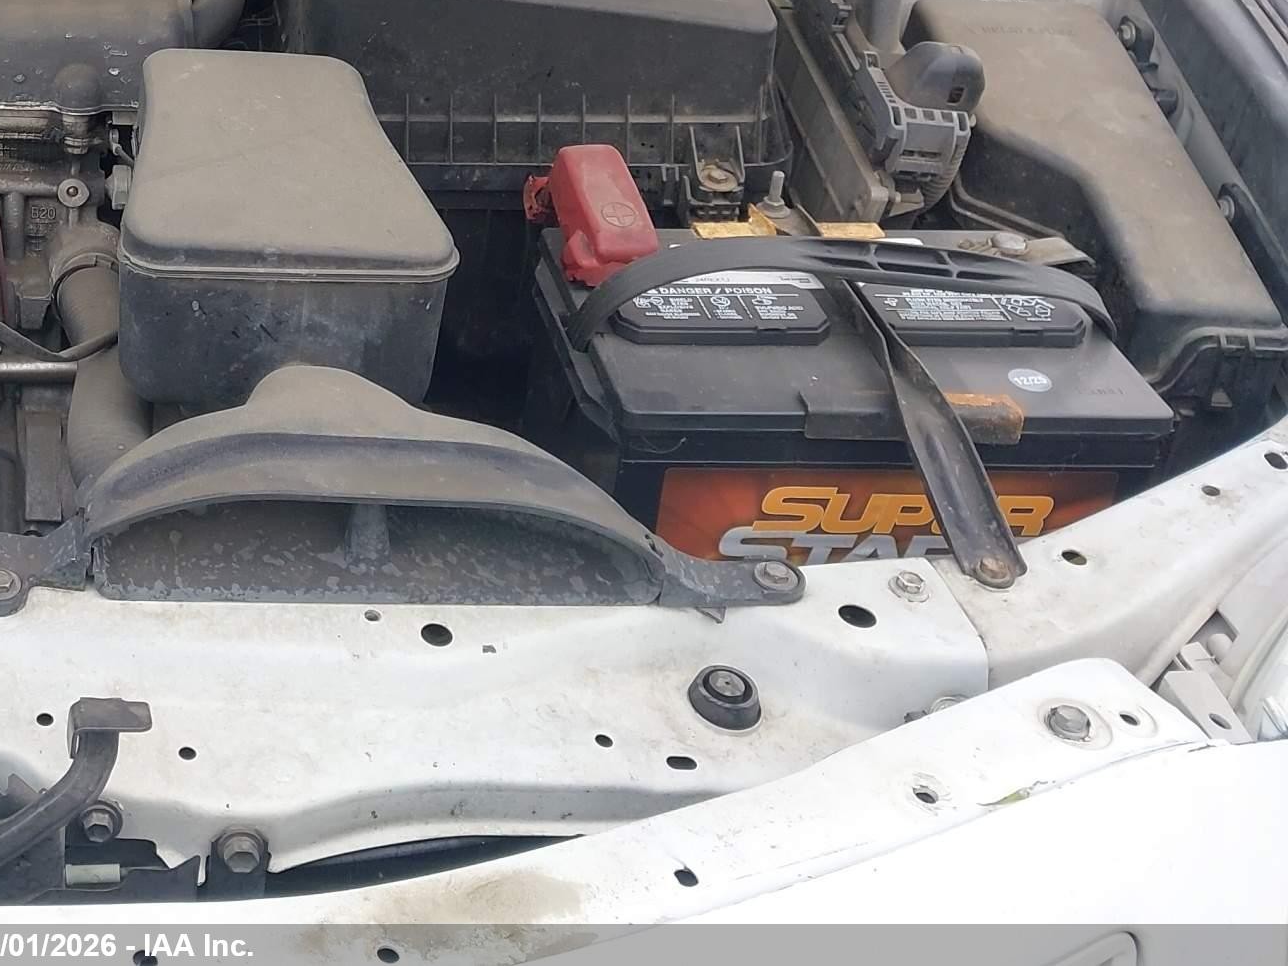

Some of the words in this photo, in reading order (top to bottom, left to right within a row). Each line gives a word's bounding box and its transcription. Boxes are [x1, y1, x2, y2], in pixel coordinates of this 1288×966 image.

[660, 287, 712, 295] DANGER
[724, 287, 773, 295] POISON
[751, 486, 1055, 535] SUPR
